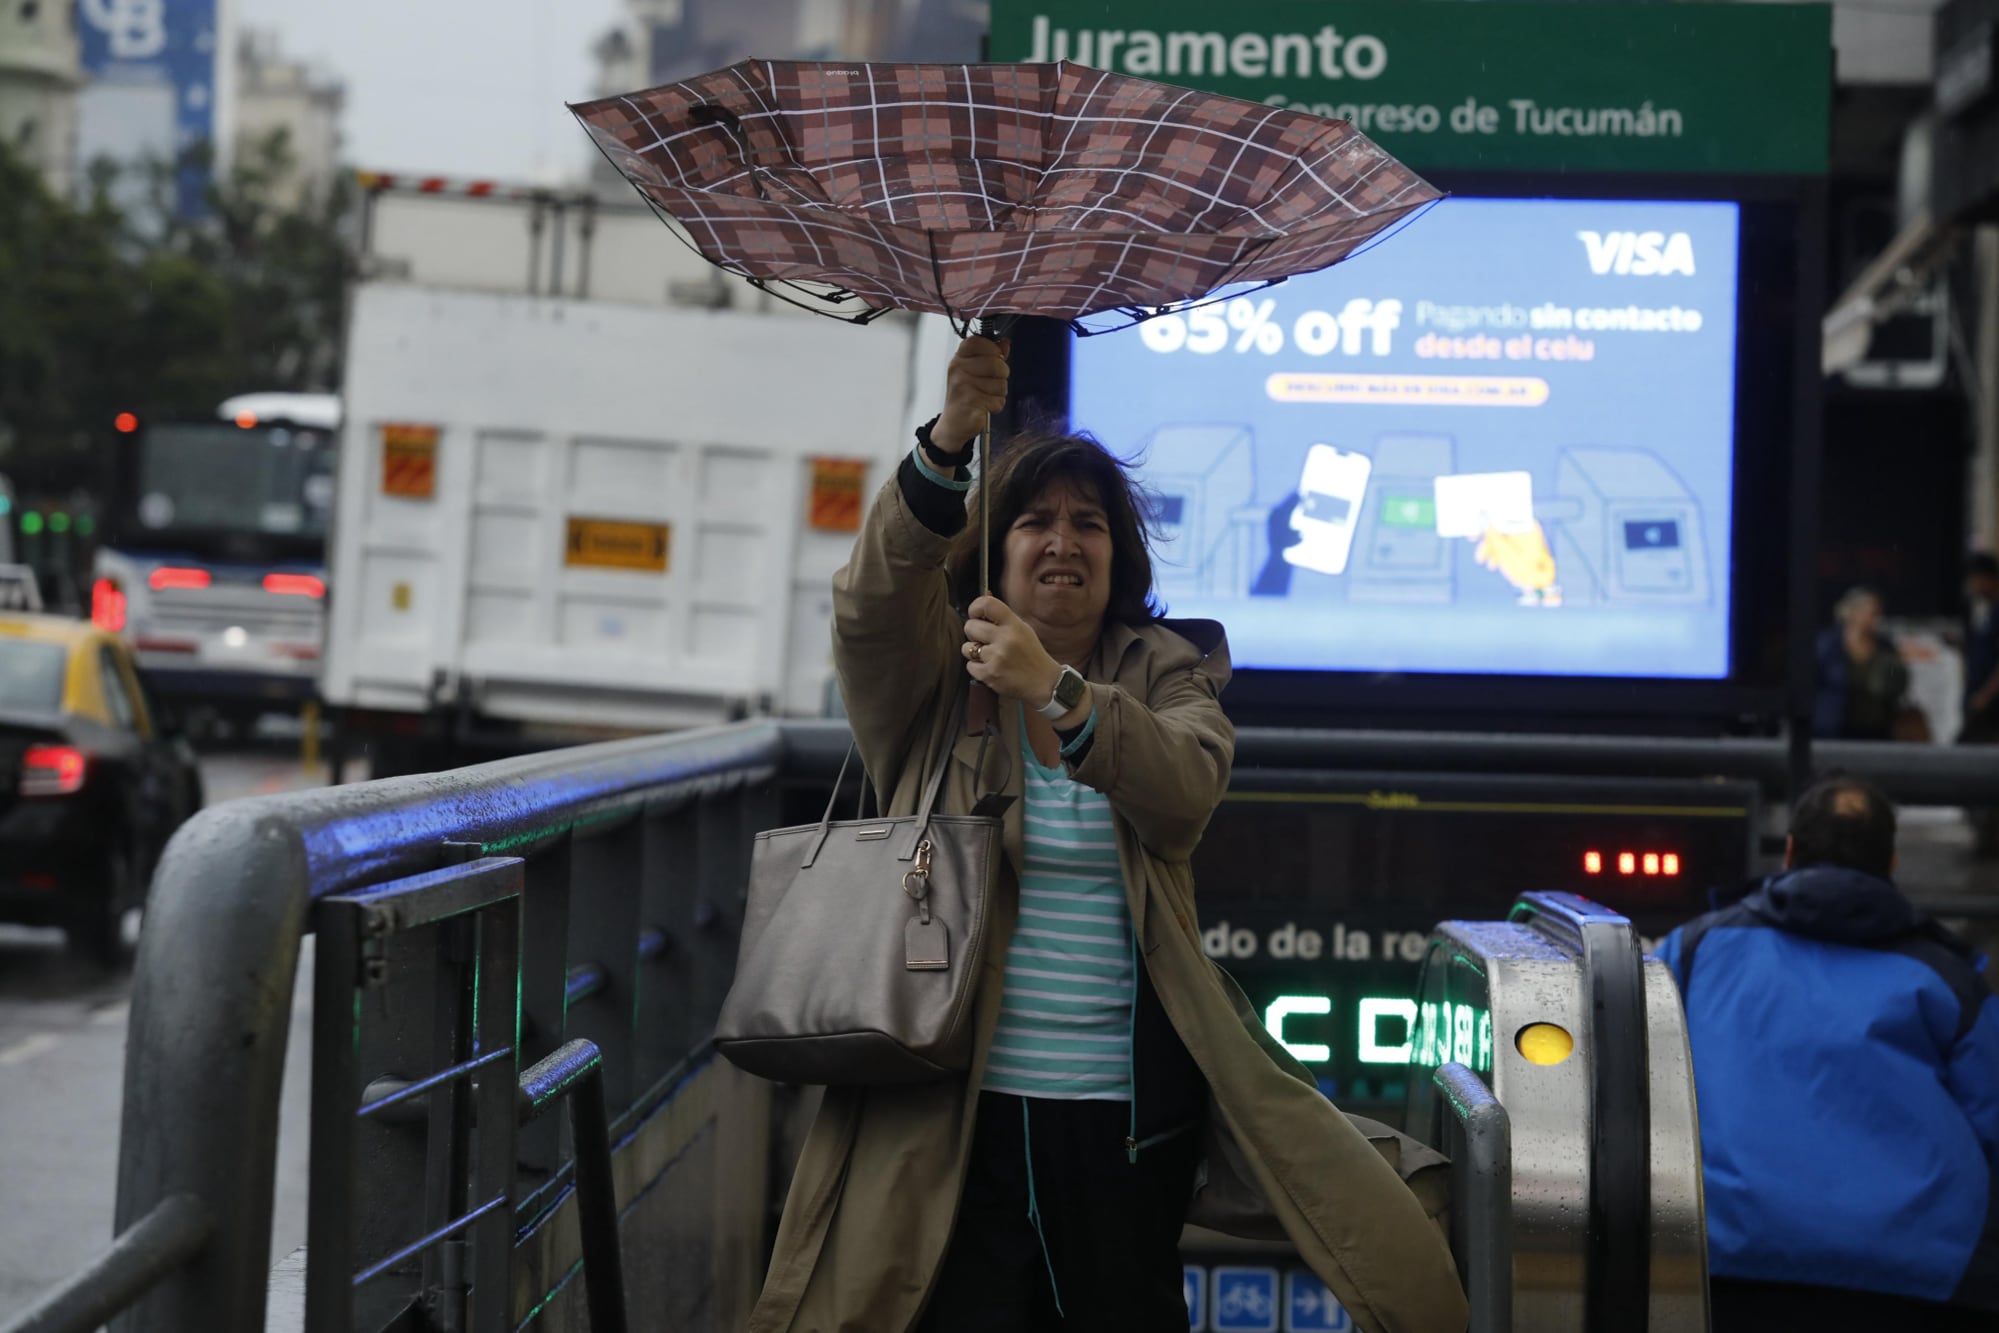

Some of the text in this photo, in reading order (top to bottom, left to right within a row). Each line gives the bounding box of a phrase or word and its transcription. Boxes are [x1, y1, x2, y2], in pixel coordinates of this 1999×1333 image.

[1022, 15, 1388, 80] Juramento
[1450, 98, 1499, 133] de
[1508, 99, 1683, 136] Tucumán
[1577, 230, 1695, 275] VISA
[1139, 297, 1402, 356] 65% off
[1415, 300, 1703, 332] Pagando sin contacto
[1415, 332, 1595, 361] desde el celu
[1268, 923, 1323, 959] de
[1333, 923, 1371, 960] la
